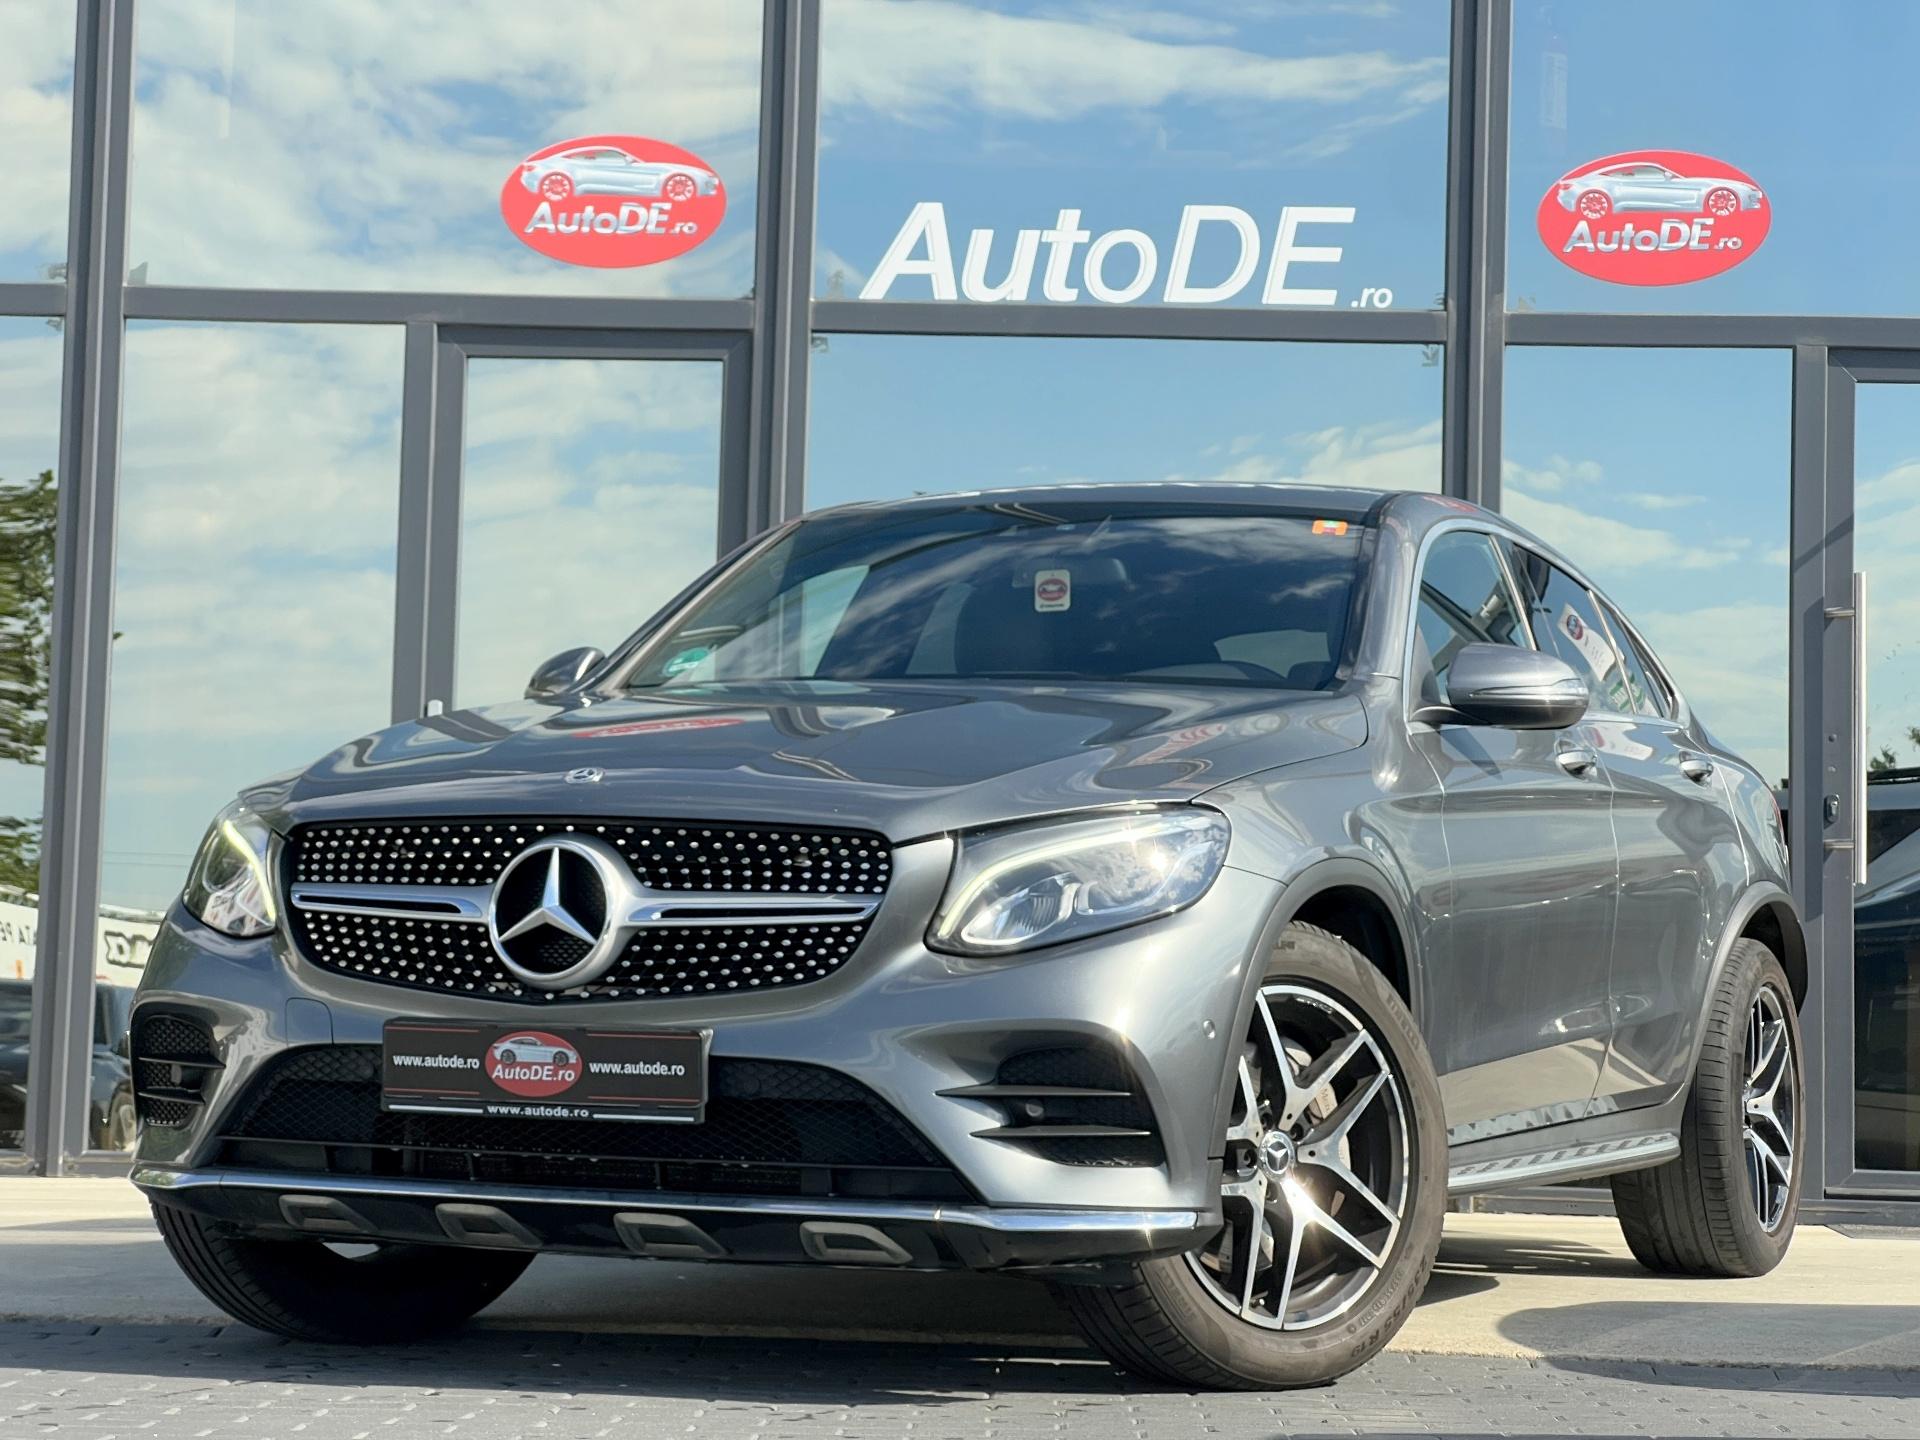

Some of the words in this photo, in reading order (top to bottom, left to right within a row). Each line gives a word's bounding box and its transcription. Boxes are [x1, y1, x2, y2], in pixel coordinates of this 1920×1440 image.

[393, 1054, 480, 1069] www.autode.ro
[492, 1064, 576, 1082] AutoDE.ro
[589, 1062, 686, 1077] www.autode.ro
[487, 1105, 590, 1118] www.autode.ro
